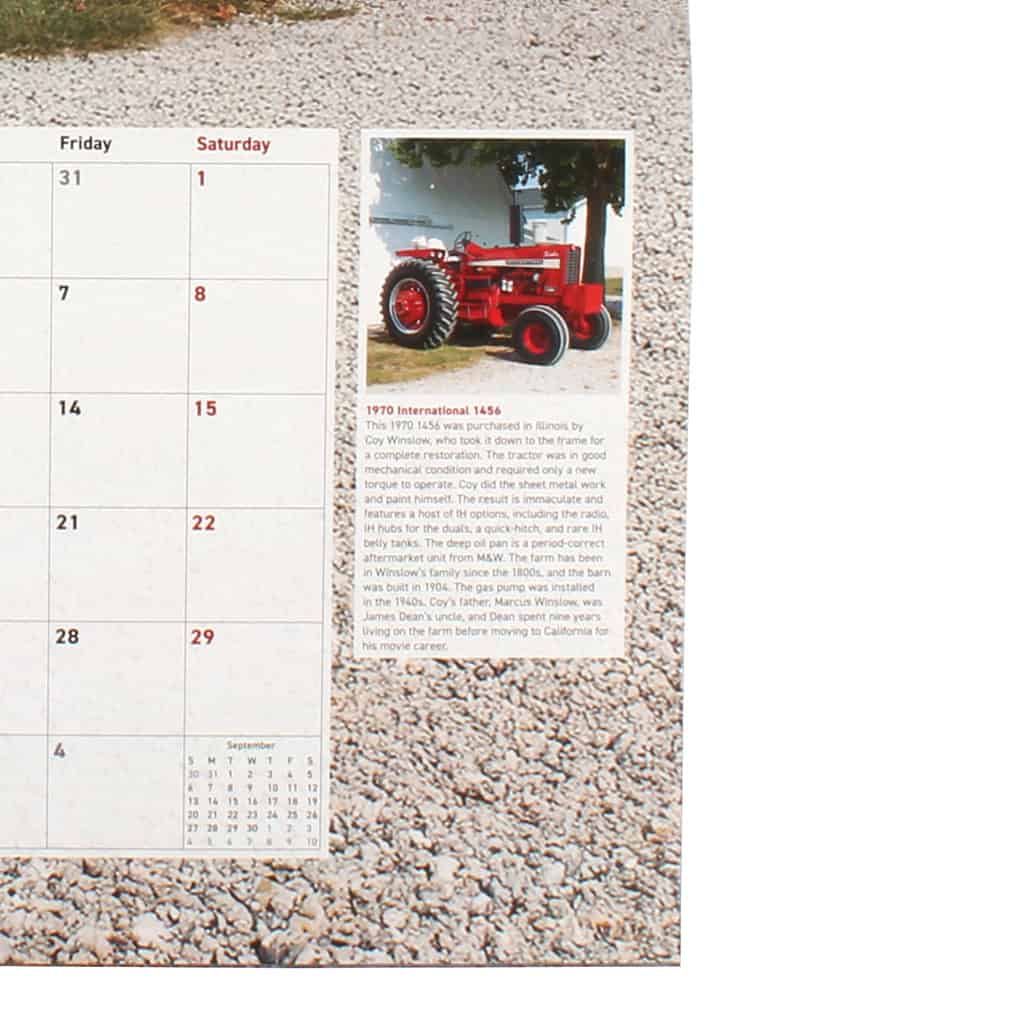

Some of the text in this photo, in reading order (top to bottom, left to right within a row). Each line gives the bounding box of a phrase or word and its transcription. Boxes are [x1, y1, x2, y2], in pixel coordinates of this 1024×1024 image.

[60, 135, 113, 154] Friday
[196, 135, 271, 155] Saturday
[59, 169, 81, 186] 31
[197, 170, 205, 187] 1
[58, 284, 70, 301] 7
[194, 285, 207, 303] 8
[58, 399, 82, 416] 14
[195, 399, 217, 417] 15
[367, 405, 501, 416] 1970 International 1456
[365, 420, 387, 430] This
[391, 420, 414, 430] 1970
[417, 420, 441, 431] 1456
[443, 423, 464, 431] was
[466, 422, 520, 432] purchased
[536, 421, 569, 431] Illinois
[365, 435, 385, 447] Coy
[435, 436, 457, 445] who
[459, 437, 482, 446] took
[494, 436, 522, 445] down
[538, 436, 554, 445] the
[557, 436, 587, 445] frame
[590, 435, 605, 446] for
[374, 450, 421, 462] complete
[486, 450, 505, 460] The
[507, 451, 543, 460] tractor
[581, 451, 607, 462] good
[364, 464, 422, 474] mechanical
[425, 465, 472, 474] condition
[473, 464, 493, 474] and
[495, 466, 540, 475] required
[542, 466, 563, 476] only
[364, 480, 398, 491] torque
[458, 479, 478, 491] Coy
[480, 480, 496, 489] did
[499, 480, 516, 489] the
[518, 480, 546, 489] sheet
[549, 480, 578, 489] metal
[581, 480, 606, 489] work
[364, 495, 384, 504] and
[386, 495, 411, 505] paint
[457, 494, 476, 504] The
[478, 496, 508, 504] result
[523, 495, 582, 504] immaculate
[584, 495, 603, 504] and
[364, 509, 406, 519] features
[418, 509, 440, 519] host
[512, 510, 559, 520] including
[561, 510, 578, 519] the
[55, 513, 78, 531] 21
[191, 514, 216, 531] 22
[377, 524, 403, 534] hubs
[405, 524, 420, 533] for
[423, 524, 440, 533] the
[545, 524, 564, 533] and
[363, 538, 388, 551] belly
[424, 538, 444, 548] The
[446, 538, 471, 550] deep
[473, 539, 486, 548] oil
[489, 540, 508, 549] pan
[531, 539, 605, 549] period-correct
[55, 627, 80, 645] 28
[191, 628, 215, 645] 29
[362, 642, 377, 651] his
[53, 742, 66, 758] 4
[227, 740, 275, 751] September
